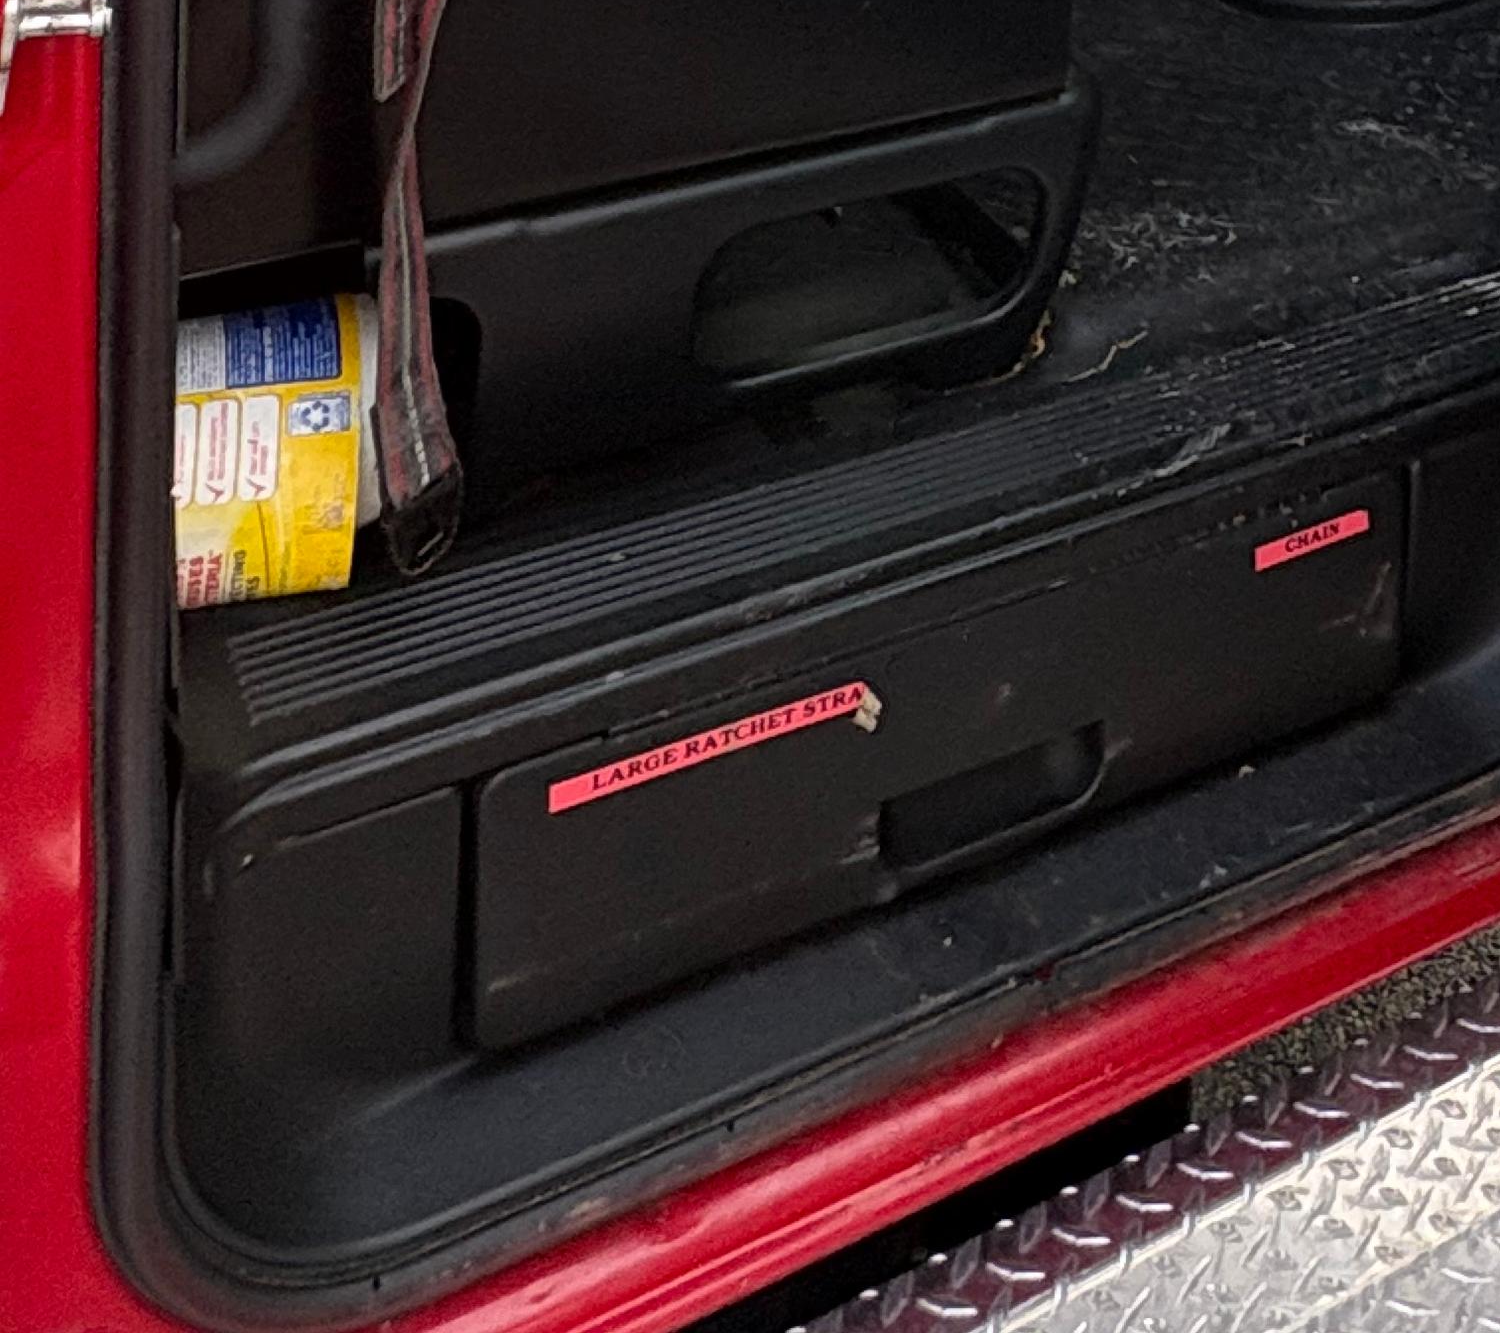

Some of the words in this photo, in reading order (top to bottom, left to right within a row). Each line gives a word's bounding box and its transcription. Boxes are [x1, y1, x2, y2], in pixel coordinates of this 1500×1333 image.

[1284, 522, 1340, 553] CHAIN
[592, 748, 679, 791] LARGE
[684, 708, 797, 759] RATCHET
